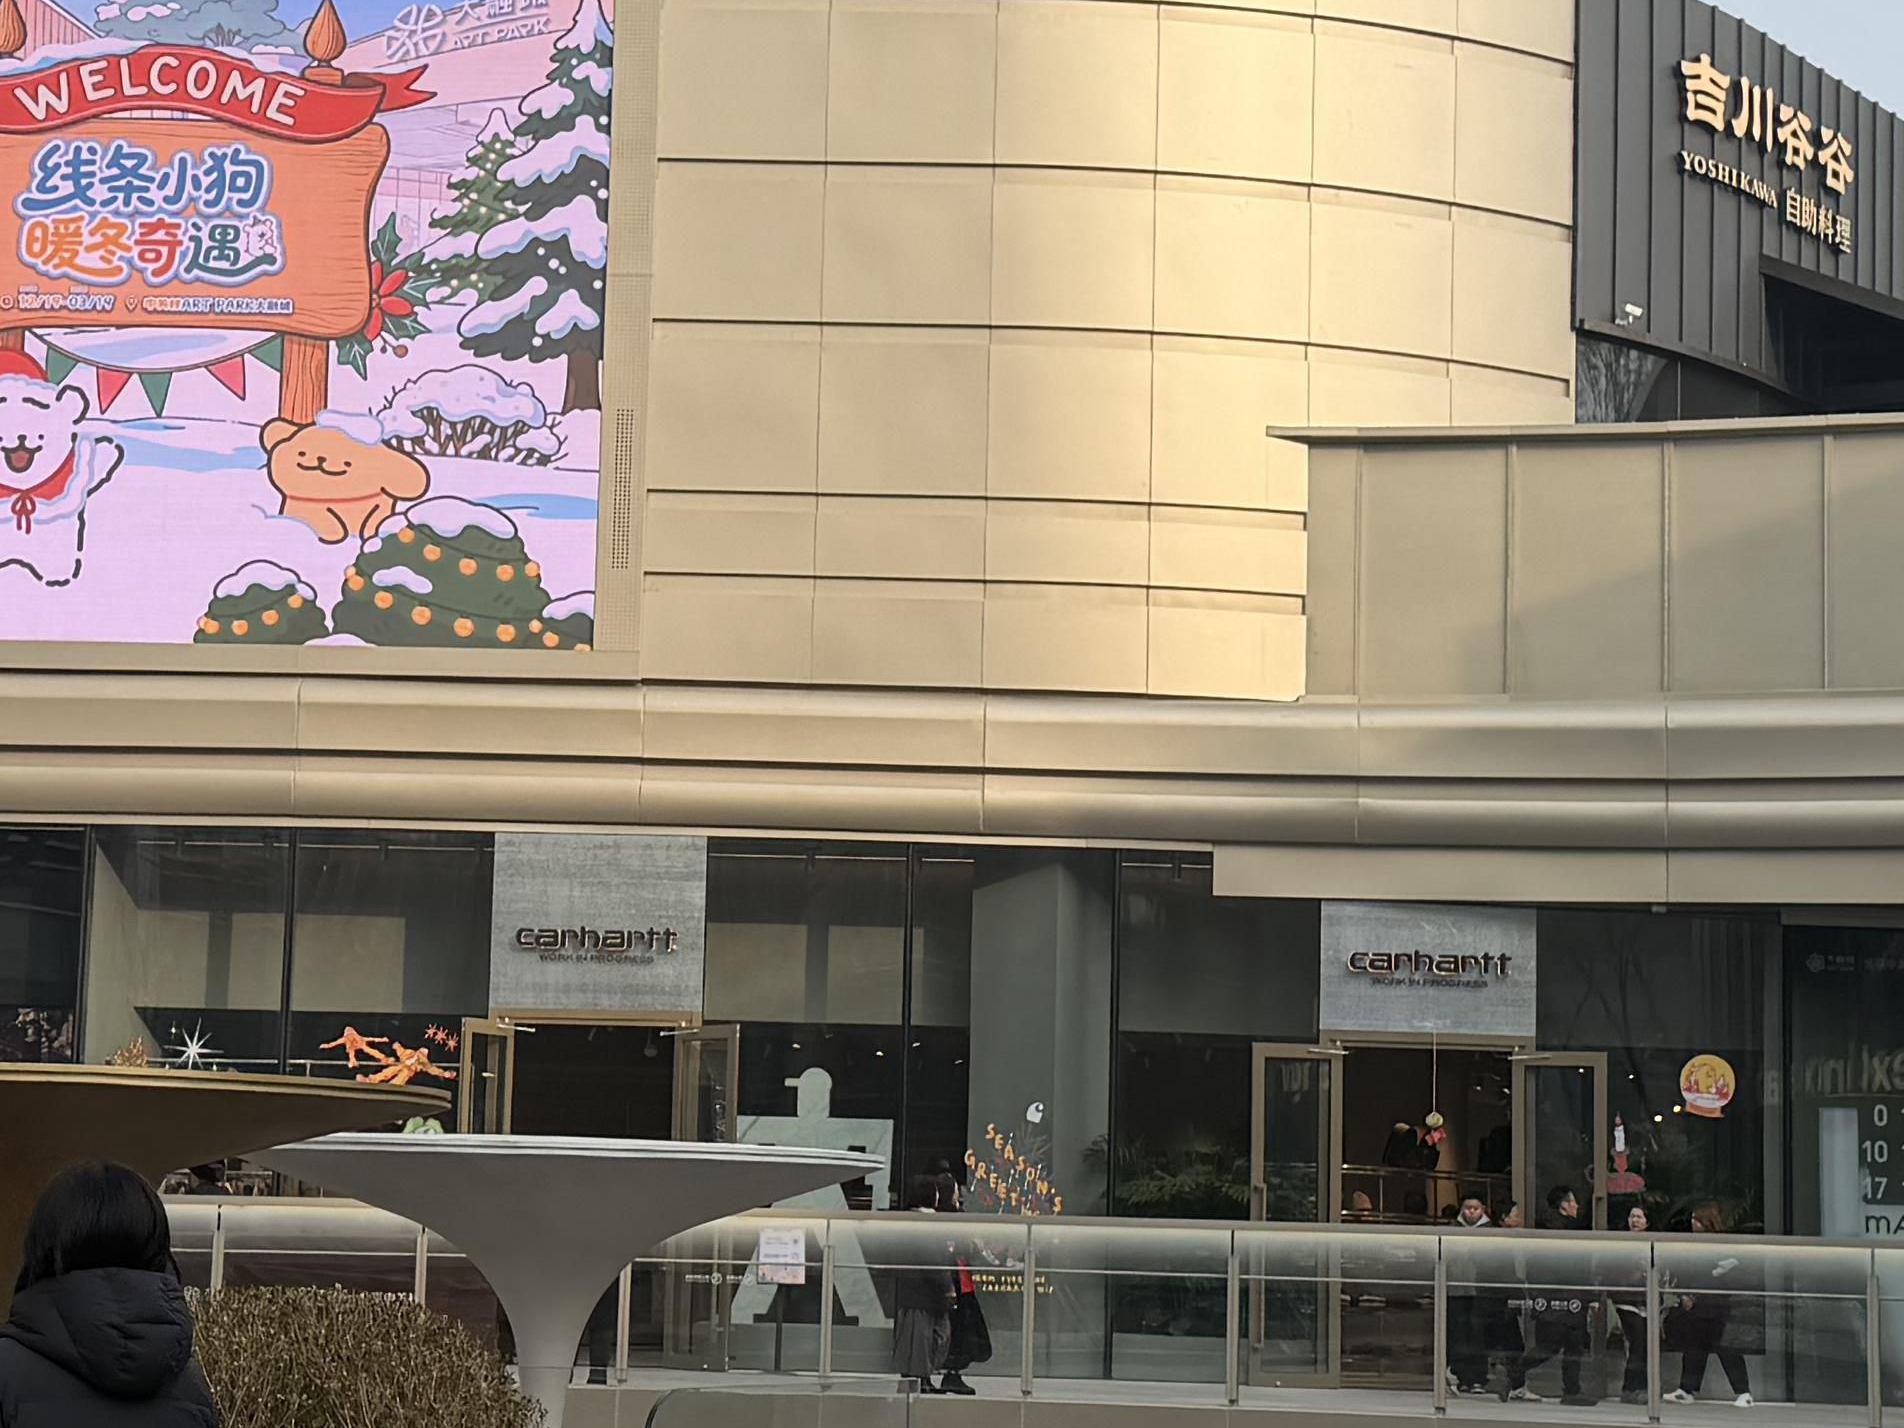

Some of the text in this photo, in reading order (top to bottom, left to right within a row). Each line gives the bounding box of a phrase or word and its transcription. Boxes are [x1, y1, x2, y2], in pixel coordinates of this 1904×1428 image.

[496, 18, 552, 40] PARK
[13, 55, 306, 127] WELCOME
[19, 142, 267, 212] 线条小狗
[1680, 150, 1852, 253] YOSHIKAWA 自助料理
[24, 214, 279, 279] 暖冬奇遇
[515, 925, 678, 952] carhartt
[1347, 949, 1512, 975] carhartt
[1873, 1104, 1888, 1127] 0
[1861, 1140, 1888, 1163] 10
[1864, 1177, 1888, 1200] 17
